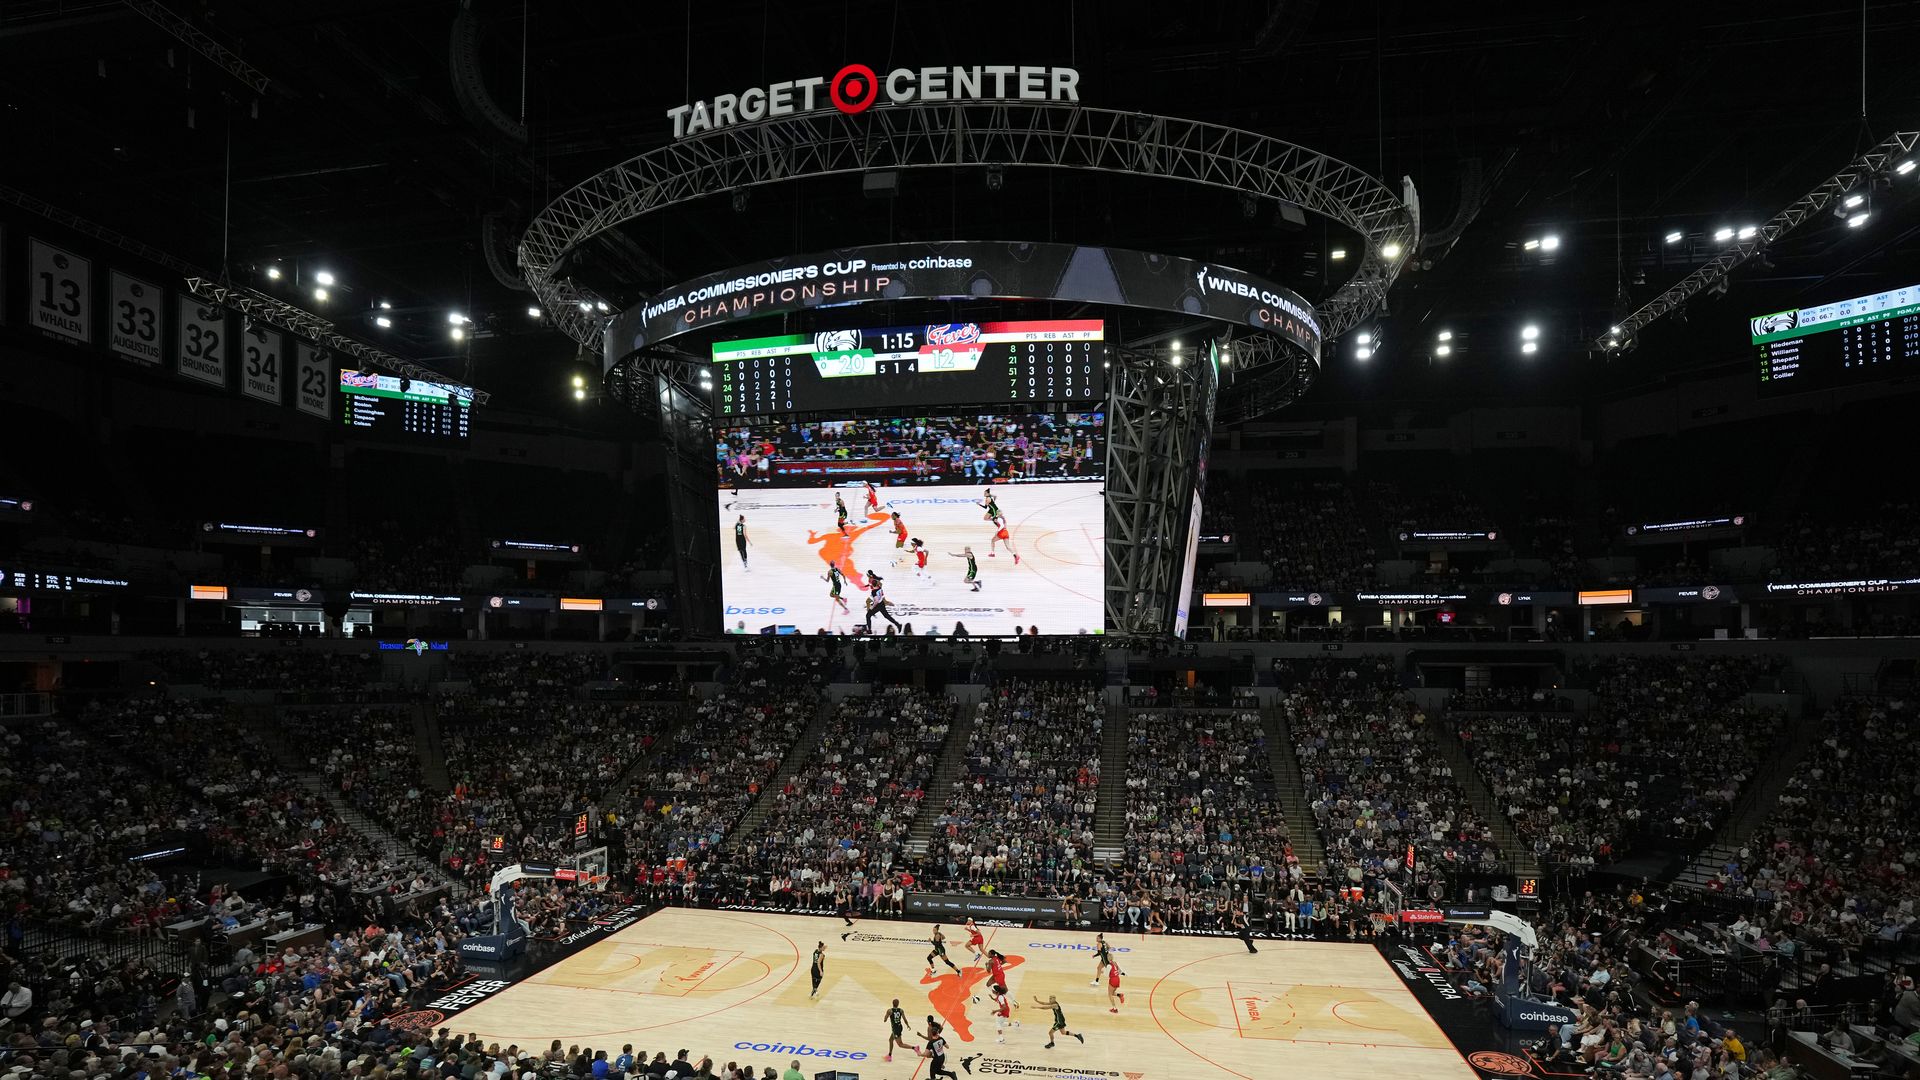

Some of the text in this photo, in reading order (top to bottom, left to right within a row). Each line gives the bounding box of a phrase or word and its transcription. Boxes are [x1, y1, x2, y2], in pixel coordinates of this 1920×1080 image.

[667, 65, 1080, 138] TARGET CENTER
[40, 272, 81, 317] 13
[647, 256, 972, 318] WNBA COMMISSIONER'S CUP Presented by coinbase
[1208, 276, 1260, 300] WNBA
[684, 277, 891, 324] CHAMPIONSHIP
[40, 310, 82, 334] WHALEN
[117, 300, 156, 342] 33
[882, 332, 914, 349] 1:15
[929, 323, 980, 344] Fever
[113, 334, 160, 358] AUGUSTUS
[185, 323, 219, 364] 32
[1010, 342, 1090, 353] 8 0 0 0 0
[1771, 339, 1803, 349] Hiedeman
[932, 348, 954, 368] 12
[1008, 354, 1072, 364] 21 0 0 0
[1771, 348, 1799, 356] Williams
[1772, 355, 1799, 364] Shepard
[182, 356, 222, 378] BRUNSON
[246, 346, 278, 382] 34
[839, 354, 864, 374] 20
[880, 362, 915, 374] 5 1 4
[1008, 365, 1090, 376] 51 3 0 0 0
[1772, 364, 1799, 372] McBride
[248, 378, 275, 396] FOWLES
[302, 366, 326, 398] 23
[755, 379, 792, 390] 2 2 0
[1010, 377, 1072, 386] 7 0 2 3
[724, 390, 776, 402] 10 5 2 2
[1011, 388, 1090, 398] 2 5 2 0 0
[302, 396, 324, 410] MOORE
[724, 400, 792, 413] 21 2 0
[1798, 585, 1898, 595] CHAMPIONSHIP
[1799, 580, 1866, 589] COMMISSIONER'S
[725, 606, 786, 614] base
[378, 641, 448, 649] Treasure Island
[576, 822, 586, 834] 23
[1523, 885, 1533, 893] 23
[604, 904, 647, 921] ULTRA
[463, 944, 495, 952] coinbase
[1424, 973, 1462, 999] ULTRA
[426, 980, 492, 1008] INDIANA
[440, 980, 511, 1010] FEVER
[1246, 1001, 1260, 1021] WNBA
[1520, 1011, 1568, 1023] coinbase
[734, 1042, 868, 1060] coinbase
[981, 1063, 1120, 1076] COMMISSIONER'S
